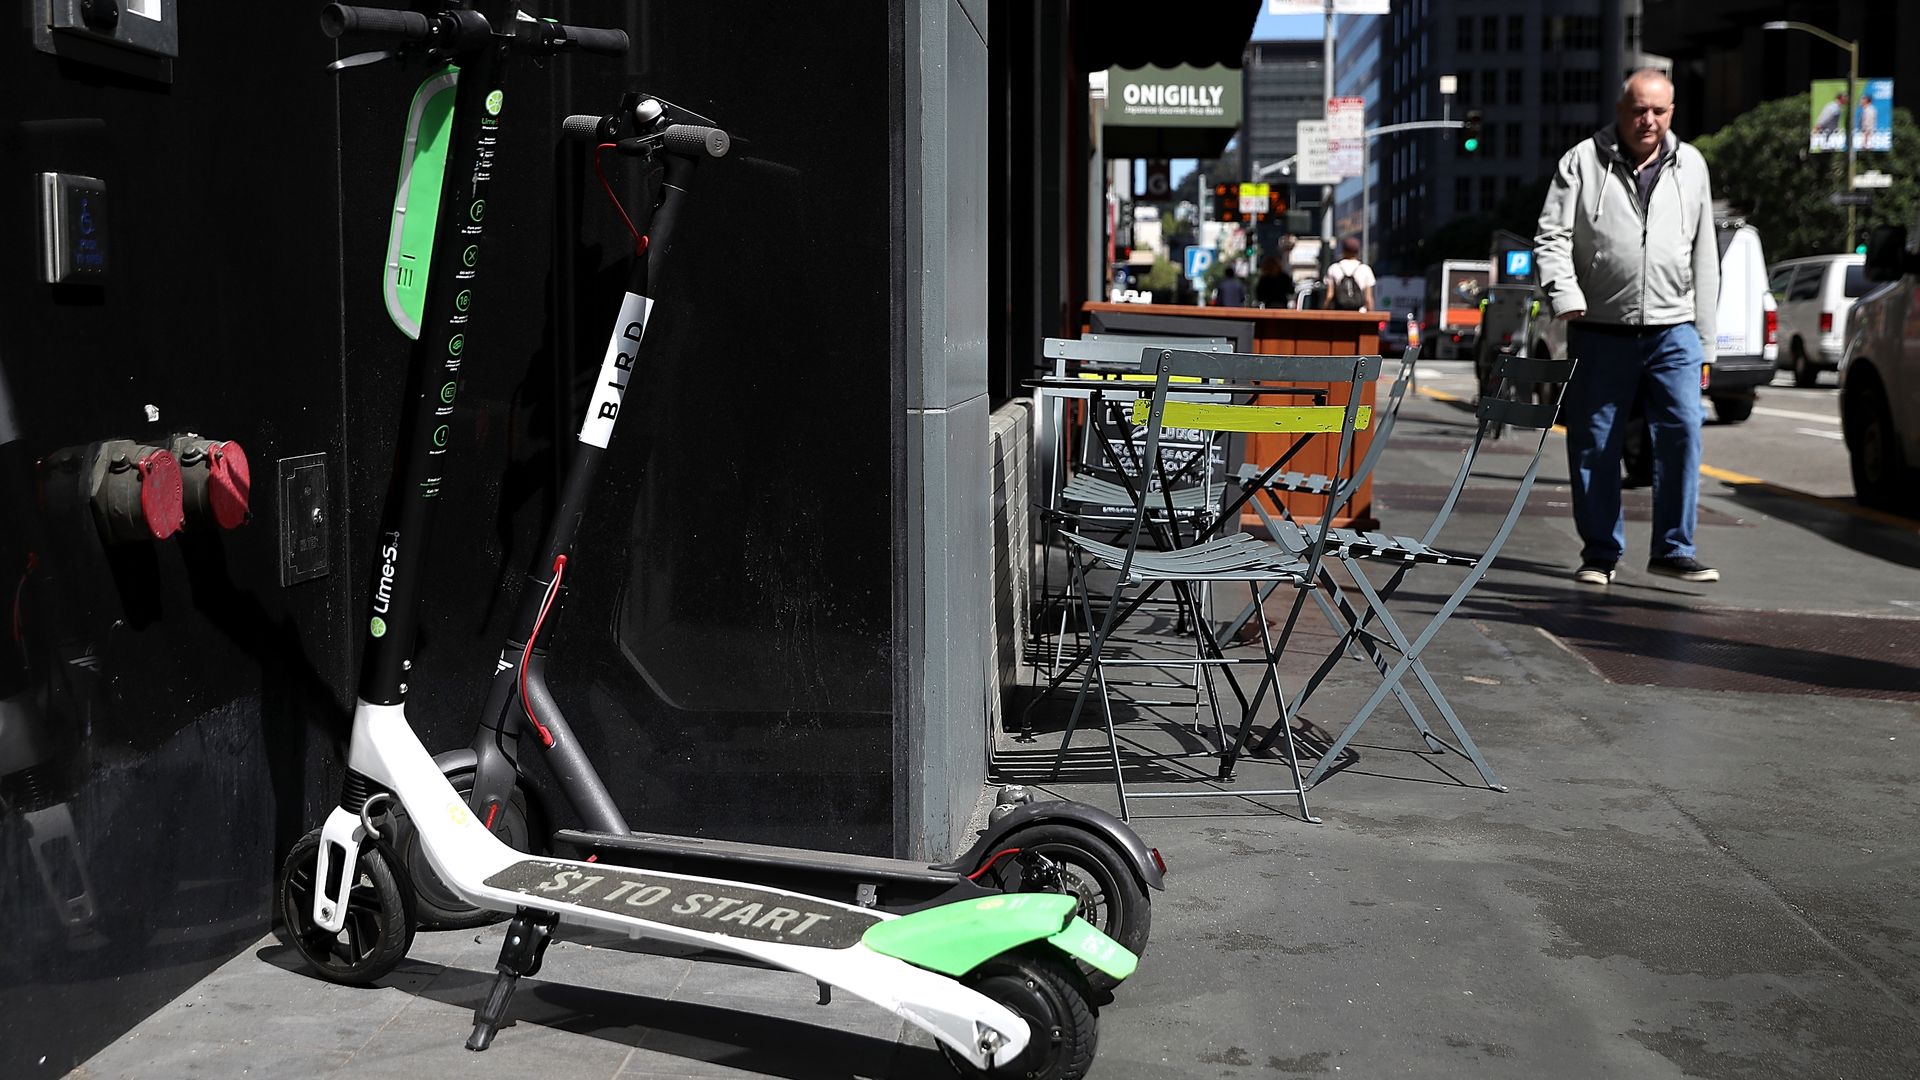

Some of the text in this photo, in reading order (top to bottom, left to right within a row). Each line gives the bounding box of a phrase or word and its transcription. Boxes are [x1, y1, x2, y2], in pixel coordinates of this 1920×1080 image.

[1123, 83, 1224, 106] ONIGILLY
[1510, 253, 1527, 273] P
[597, 320, 645, 420] BIRD
[539, 869, 831, 936] $1 TO START
